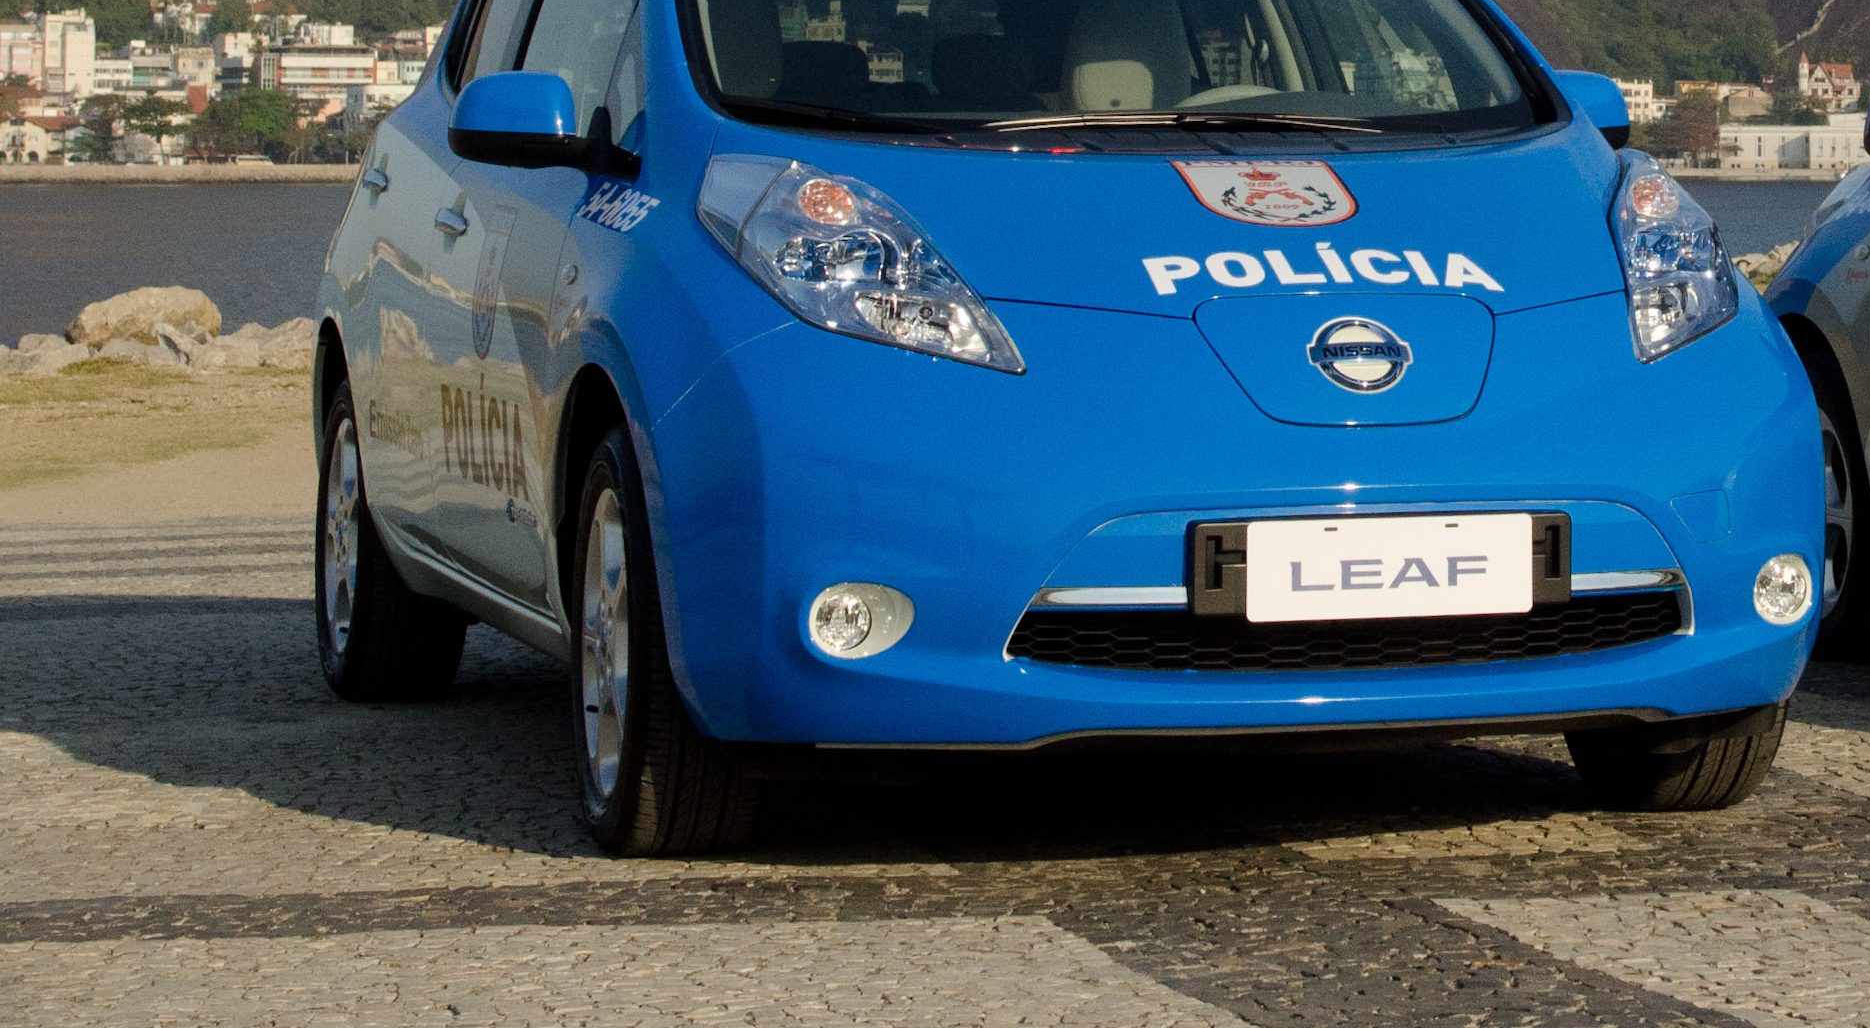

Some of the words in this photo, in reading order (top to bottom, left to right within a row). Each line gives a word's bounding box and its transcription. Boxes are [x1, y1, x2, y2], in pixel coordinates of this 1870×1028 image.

[1142, 241, 1505, 296] POLÍCIA
[1322, 344, 1402, 359] NISSAN
[441, 372, 530, 502] POLÍCIA
[1289, 555, 1489, 592] LEAF
